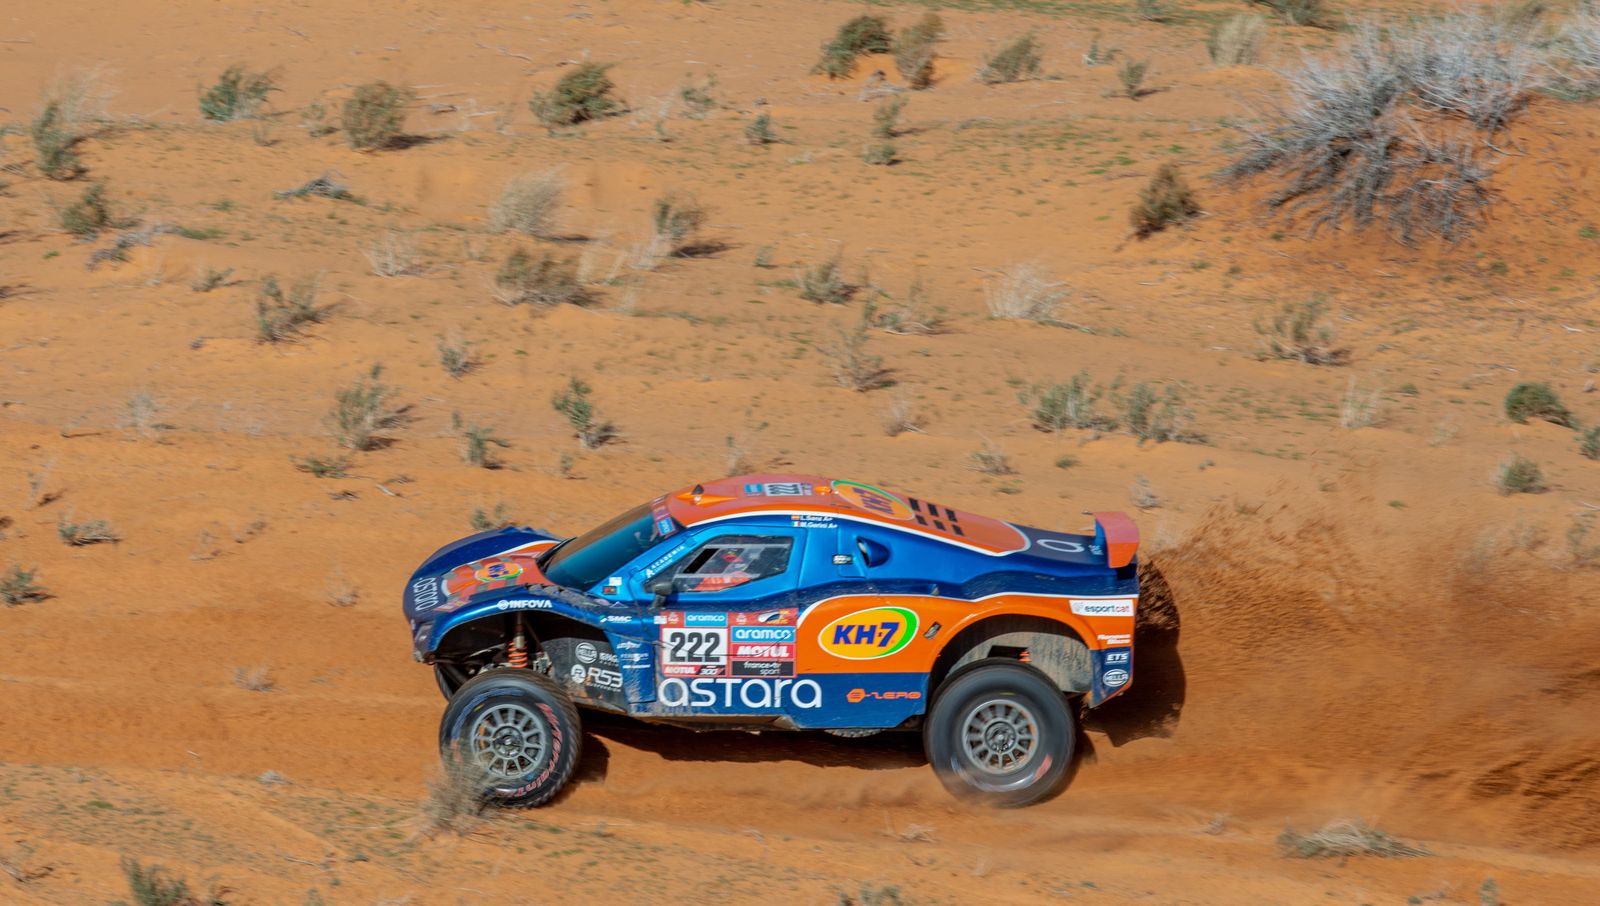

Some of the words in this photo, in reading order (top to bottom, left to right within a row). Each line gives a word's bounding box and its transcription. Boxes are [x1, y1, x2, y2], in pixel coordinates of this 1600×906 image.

[509, 599, 552, 609] INFOVA
[687, 614, 726, 622] aramco
[735, 629, 791, 639] aramco
[670, 632, 720, 662] 222
[737, 646, 789, 657] MOTUL
[664, 666, 697, 674] MOTUL
[658, 678, 822, 708] astara
